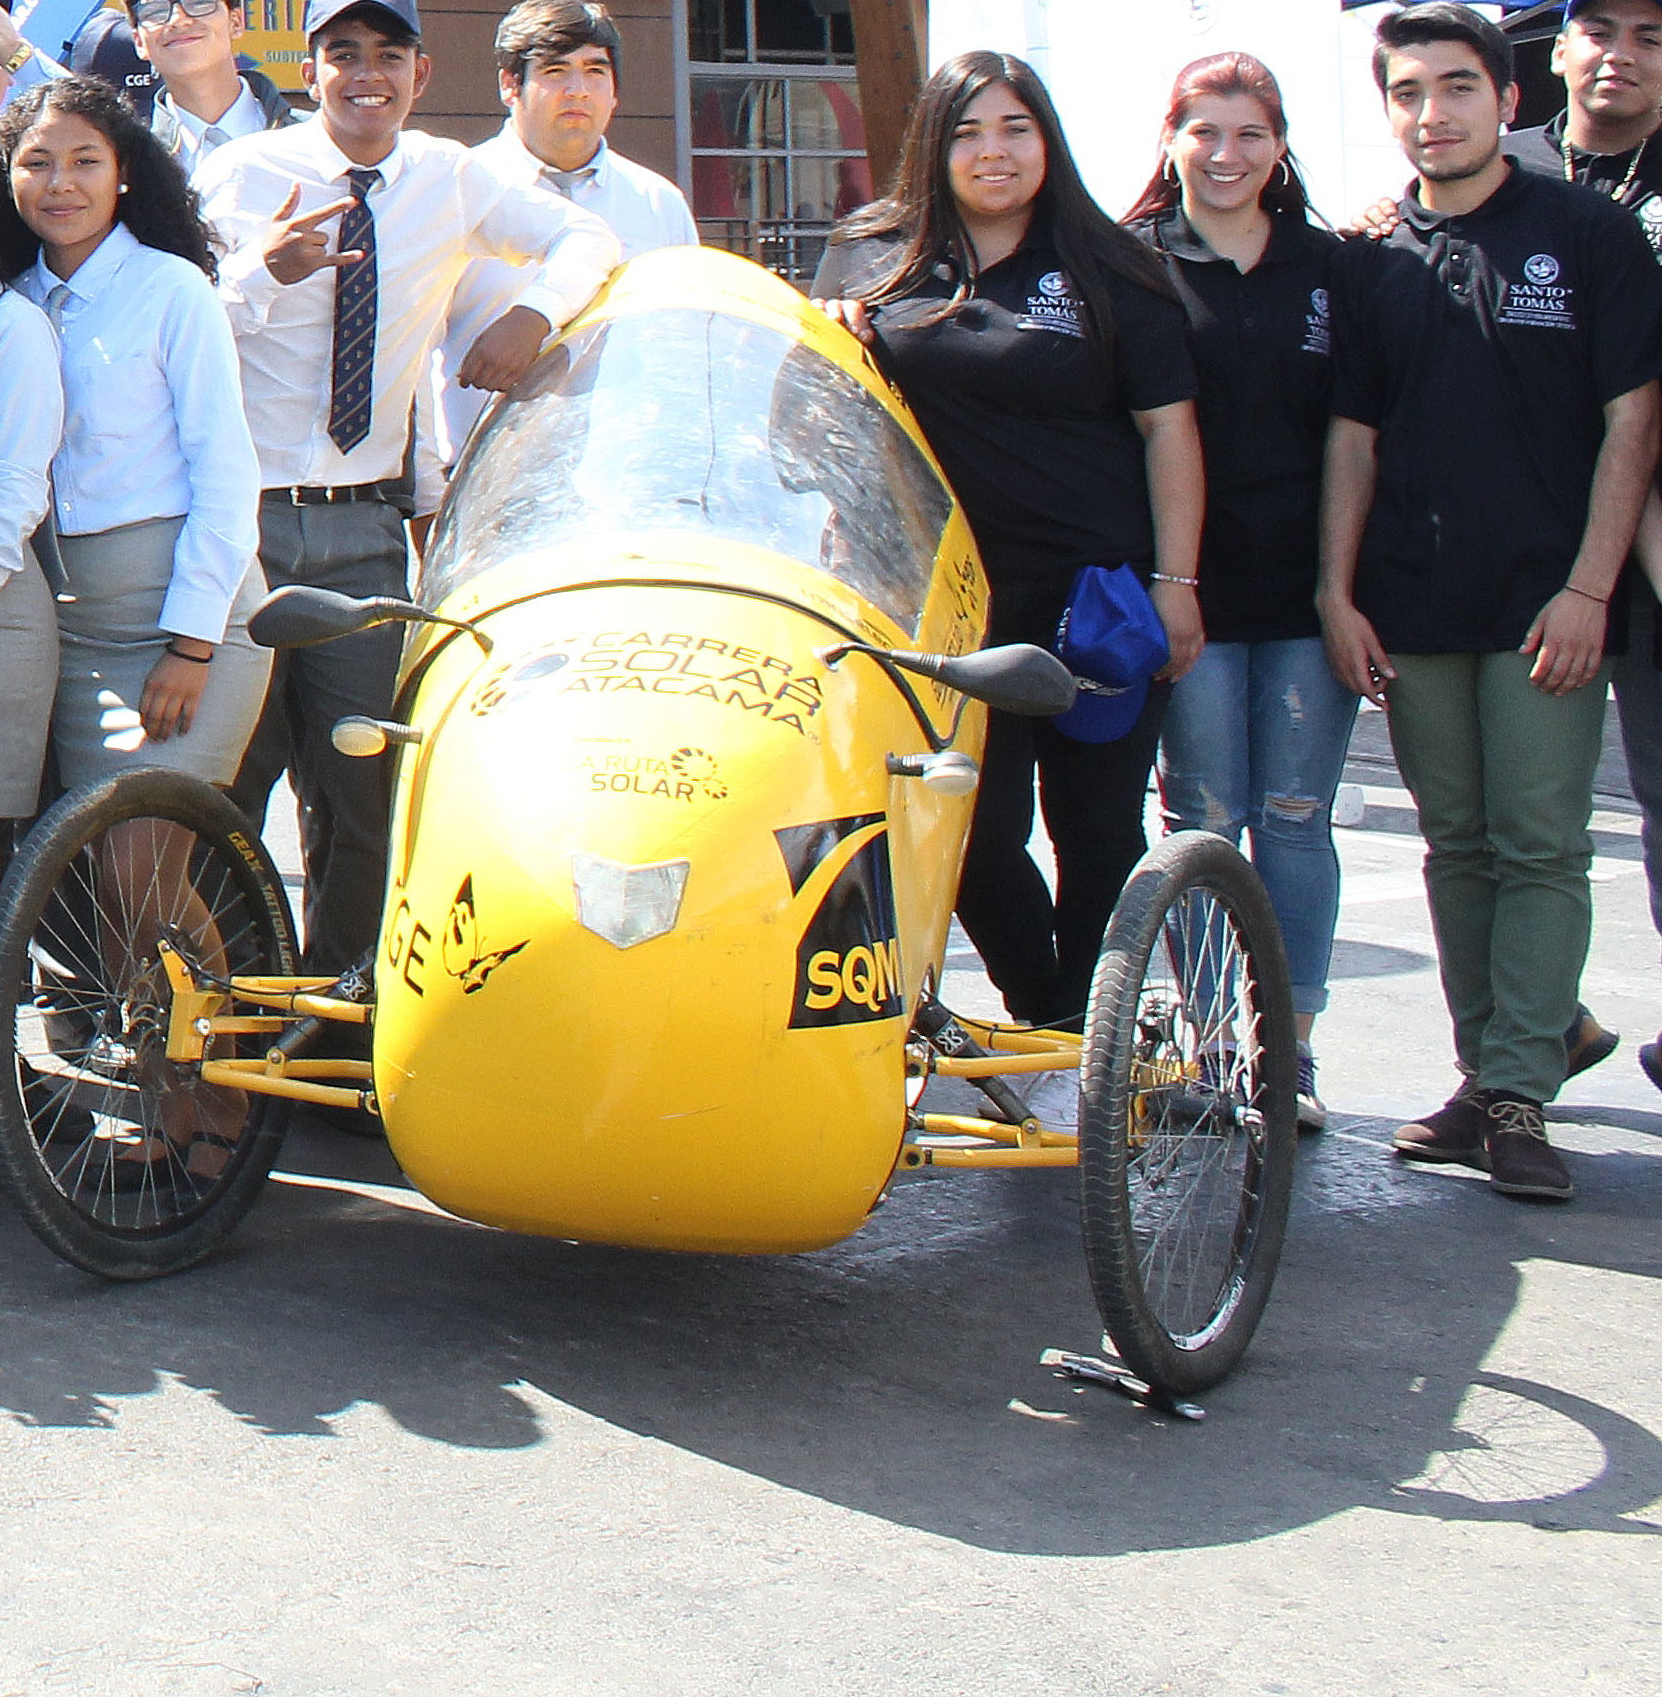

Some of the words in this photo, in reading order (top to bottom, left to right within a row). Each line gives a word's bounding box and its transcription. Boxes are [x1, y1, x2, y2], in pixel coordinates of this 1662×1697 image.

[125, 73, 152, 87] CGE
[1510, 284, 1566, 298] SANTO
[573, 650, 822, 717] SOLAR
[592, 632, 824, 697] CARRERA
[561, 676, 805, 736] ATACAMA
[590, 773, 696, 803] SOLAR
[605, 755, 670, 776] RUTA
[386, 898, 432, 998] GE
[804, 938, 904, 1013] SQM
